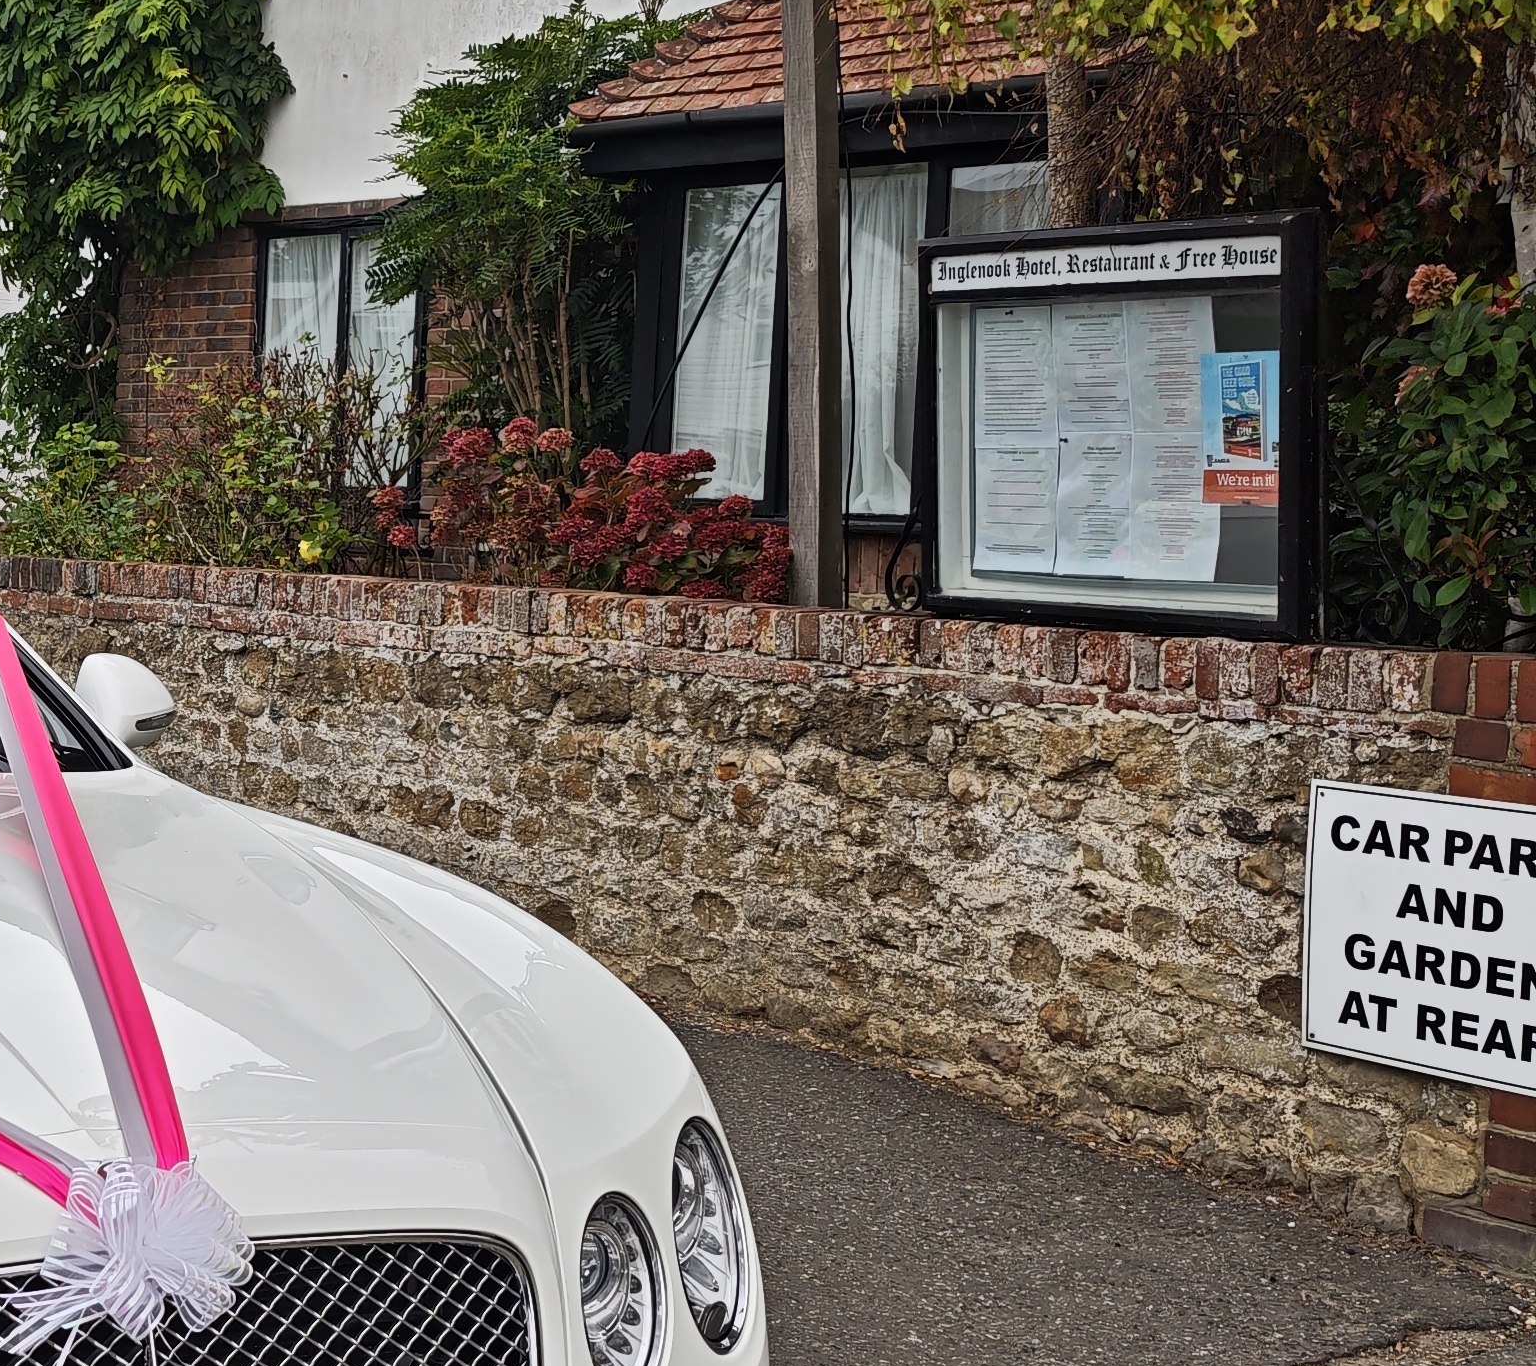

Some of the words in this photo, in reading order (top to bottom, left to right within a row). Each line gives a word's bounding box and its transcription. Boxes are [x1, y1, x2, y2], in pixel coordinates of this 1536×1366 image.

[938, 259, 1011, 283] Inglenook
[1015, 256, 1061, 280] Hotel,
[1066, 252, 1155, 274] Restaurant
[1159, 254, 1170, 270] &
[1174, 248, 1216, 272] Free
[1221, 245, 1277, 270] House
[1216, 473, 1250, 486] We're
[1252, 472, 1264, 486] in
[1265, 473, 1275, 486] it!
[1331, 814, 1430, 863] CAR
[1396, 883, 1504, 933] AND
[1338, 990, 1397, 1033] AT
